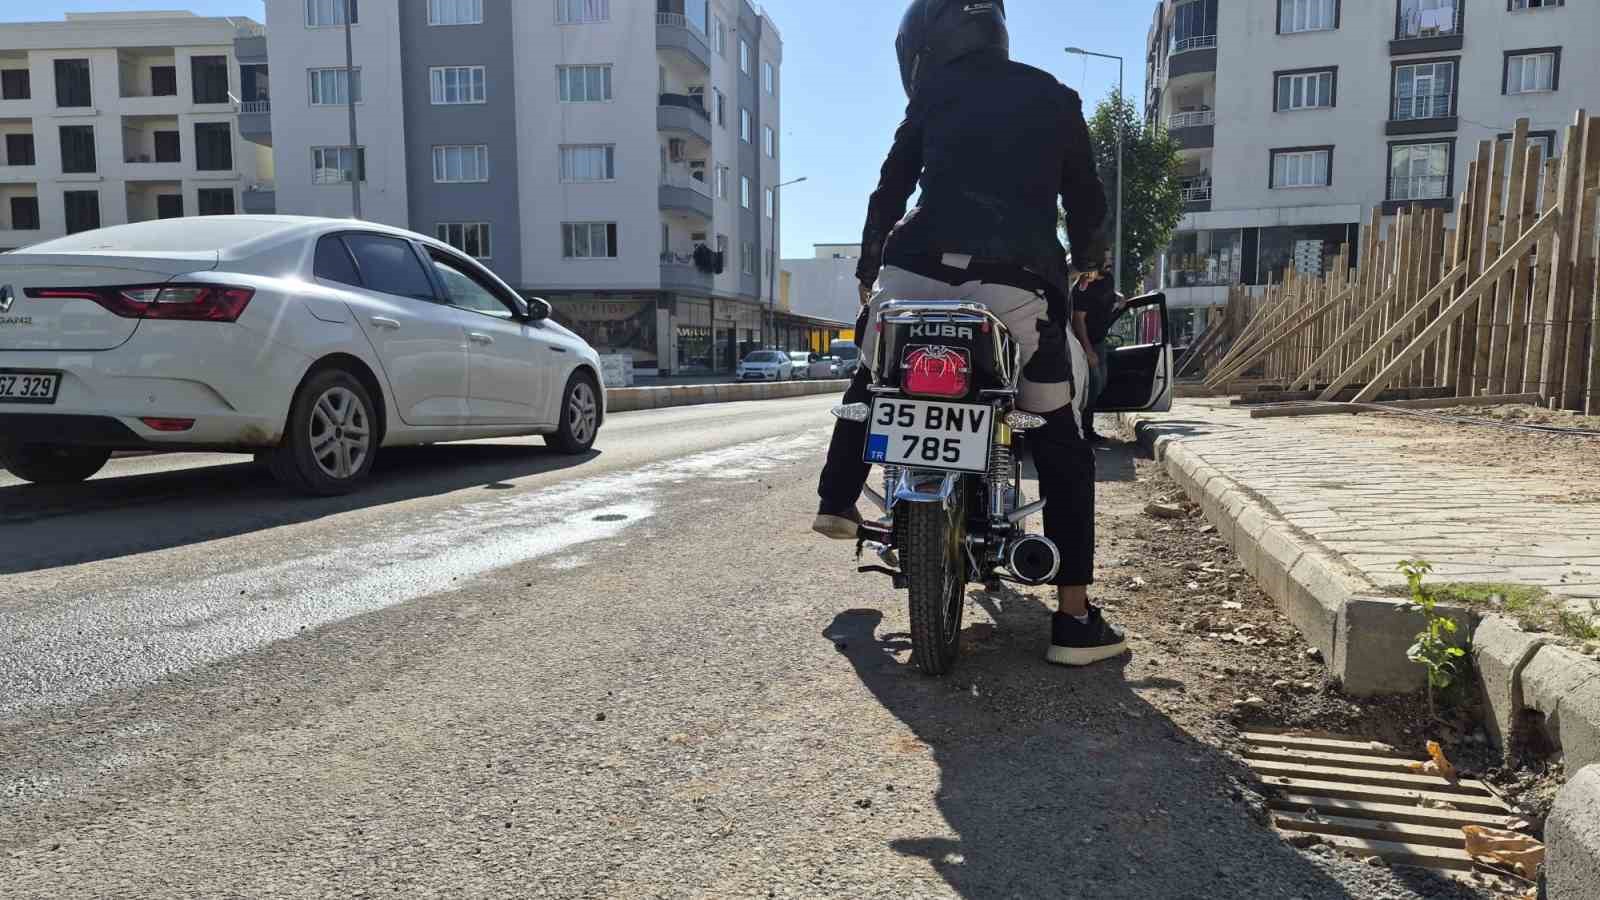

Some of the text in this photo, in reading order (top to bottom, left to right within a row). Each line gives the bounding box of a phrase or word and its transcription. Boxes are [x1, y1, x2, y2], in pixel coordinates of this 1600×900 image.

[910, 323, 972, 339] KUBA
[20, 377, 51, 396] 329
[877, 403, 985, 433] 35 BNV
[871, 435, 960, 462] TR 785
